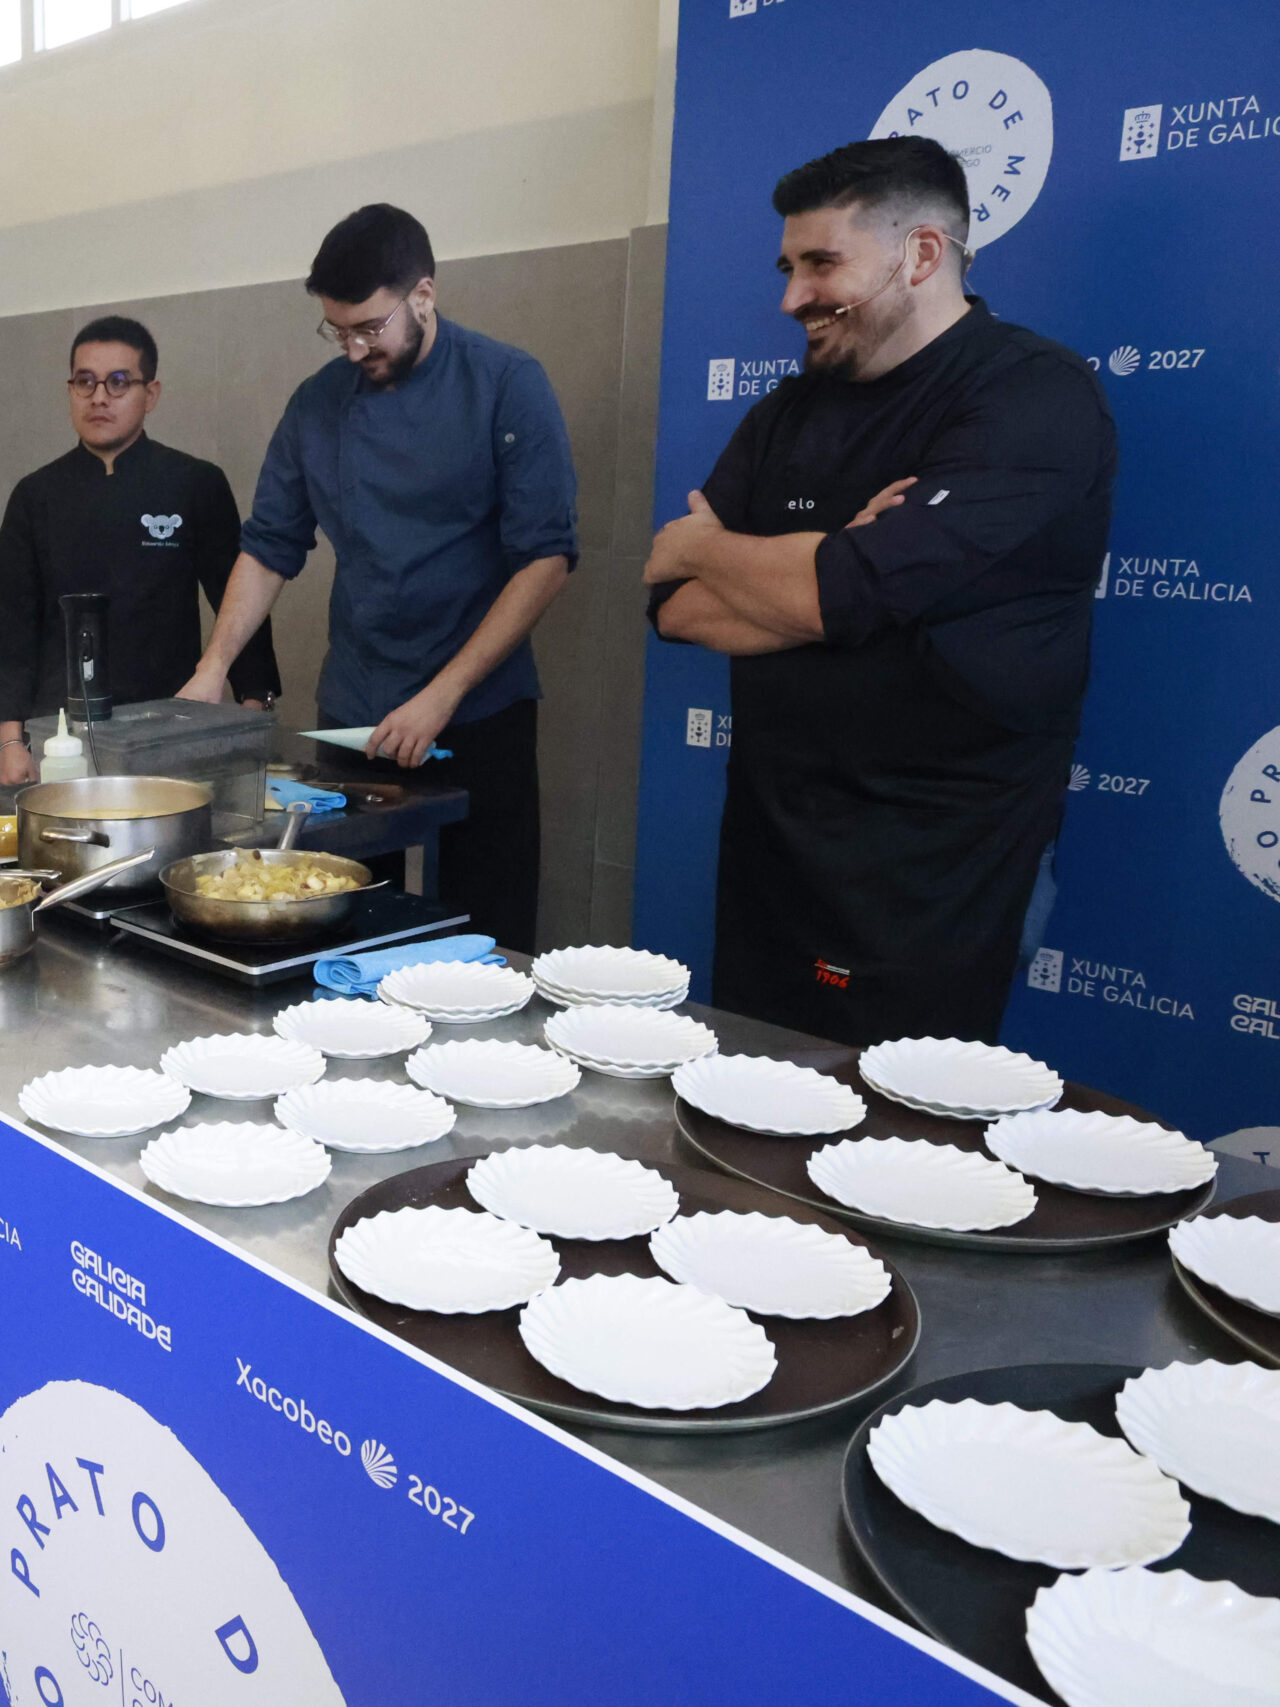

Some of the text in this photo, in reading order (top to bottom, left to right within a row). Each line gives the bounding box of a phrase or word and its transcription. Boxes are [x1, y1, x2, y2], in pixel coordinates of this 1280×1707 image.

[988, 89, 1024, 130] DE
[1170, 94, 1261, 127] XUNTA
[1167, 127, 1200, 151] DE
[740, 358, 800, 377] XUNTA
[1147, 348, 1206, 370] 2027
[738, 379, 761, 396] DE
[1117, 556, 1201, 578] XUNTA
[1114, 578, 1253, 603] DE GALICIA
[1097, 773, 1151, 796] 2027
[1070, 957, 1147, 990] XUNTA
[1067, 976, 1196, 1021] DE GALICIA
[70, 1240, 147, 1308] GALICIA
[71, 1268, 173, 1353] CALIDADE
[236, 1356, 476, 1535] Xacobeo 2027
[10, 1456, 166, 1600] PRATO
